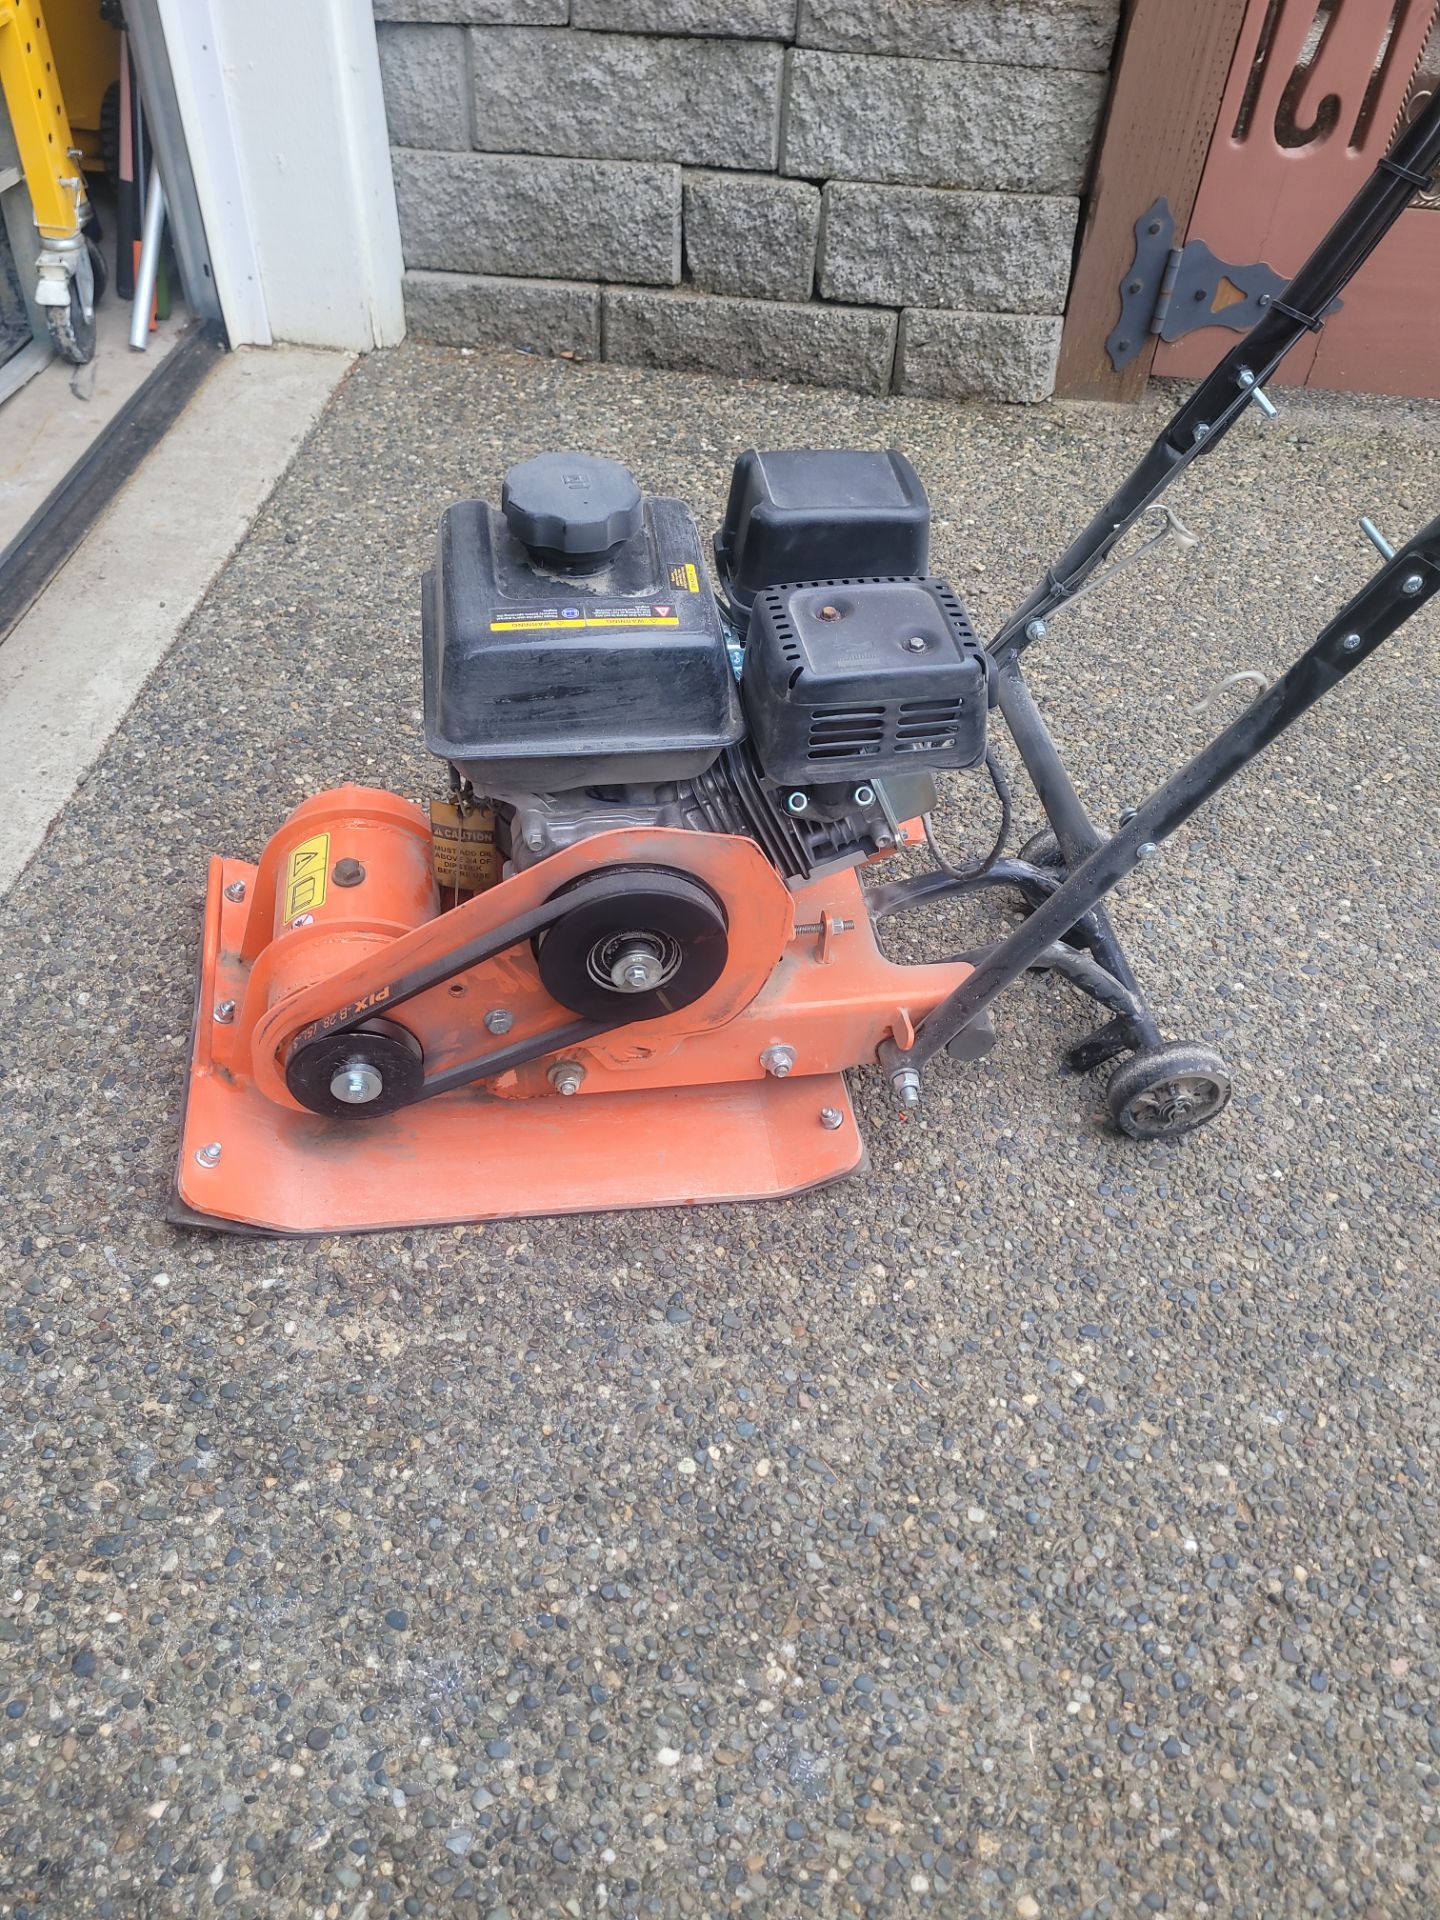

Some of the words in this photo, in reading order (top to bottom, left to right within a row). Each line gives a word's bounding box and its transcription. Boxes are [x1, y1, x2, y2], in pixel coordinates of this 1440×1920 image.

[444, 829, 493, 842] CAUTION
[434, 845, 456, 854] MUST
[354, 985, 390, 1014] PIX
